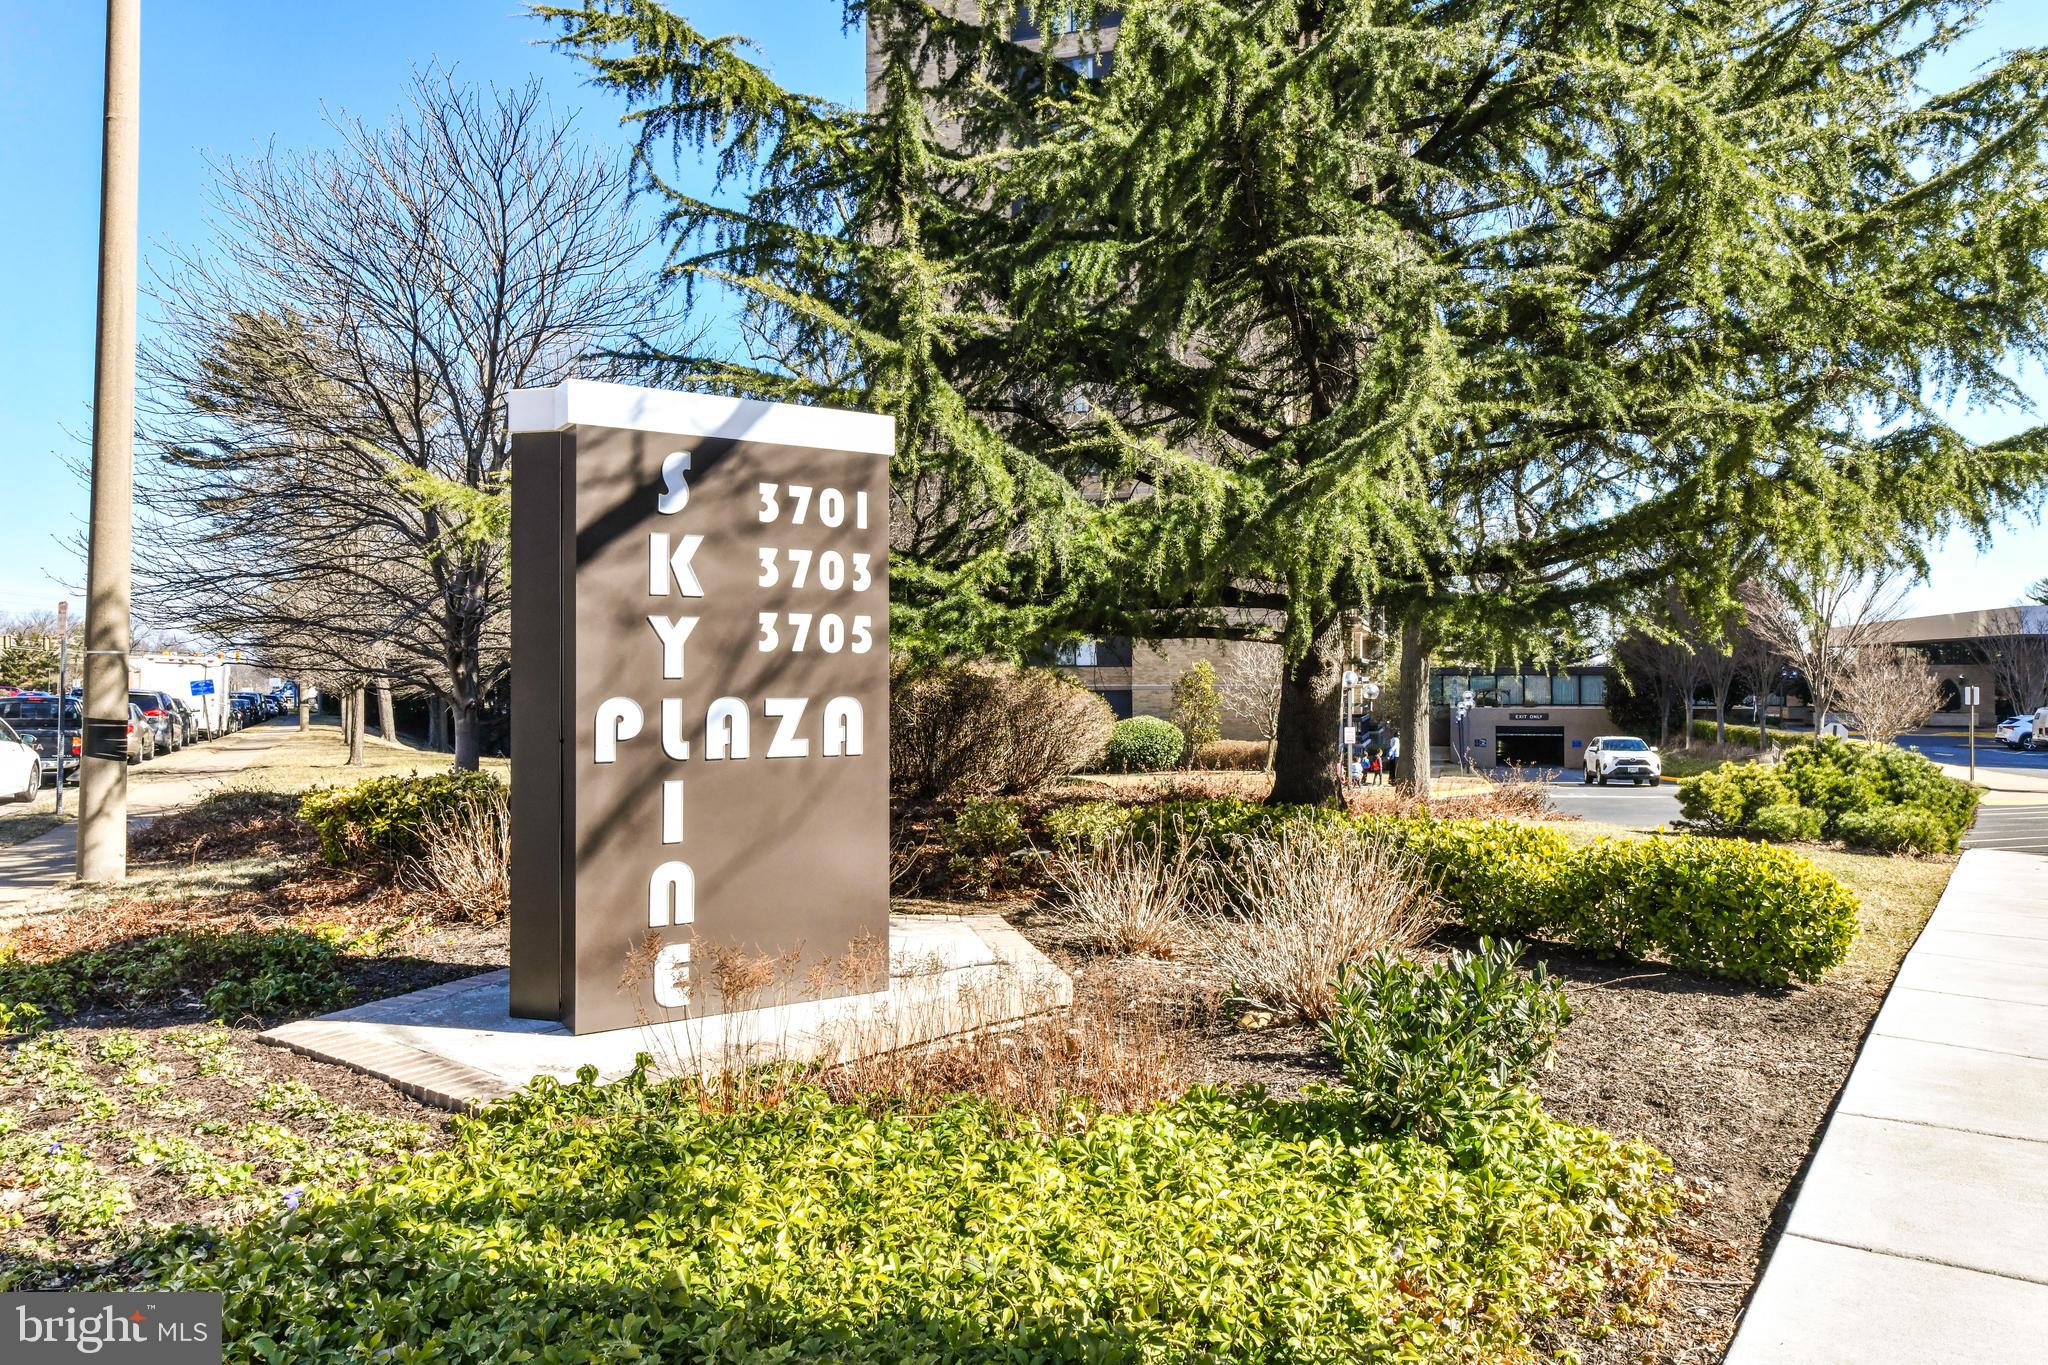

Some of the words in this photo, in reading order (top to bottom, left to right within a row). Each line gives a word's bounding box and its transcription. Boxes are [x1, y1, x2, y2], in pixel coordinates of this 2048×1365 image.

[758, 482, 868, 530] 3701
[758, 547, 872, 592] 3703
[758, 612, 873, 654] 3705
[594, 696, 864, 764] PLAZA
[647, 450, 705, 1008] SKYLINE
